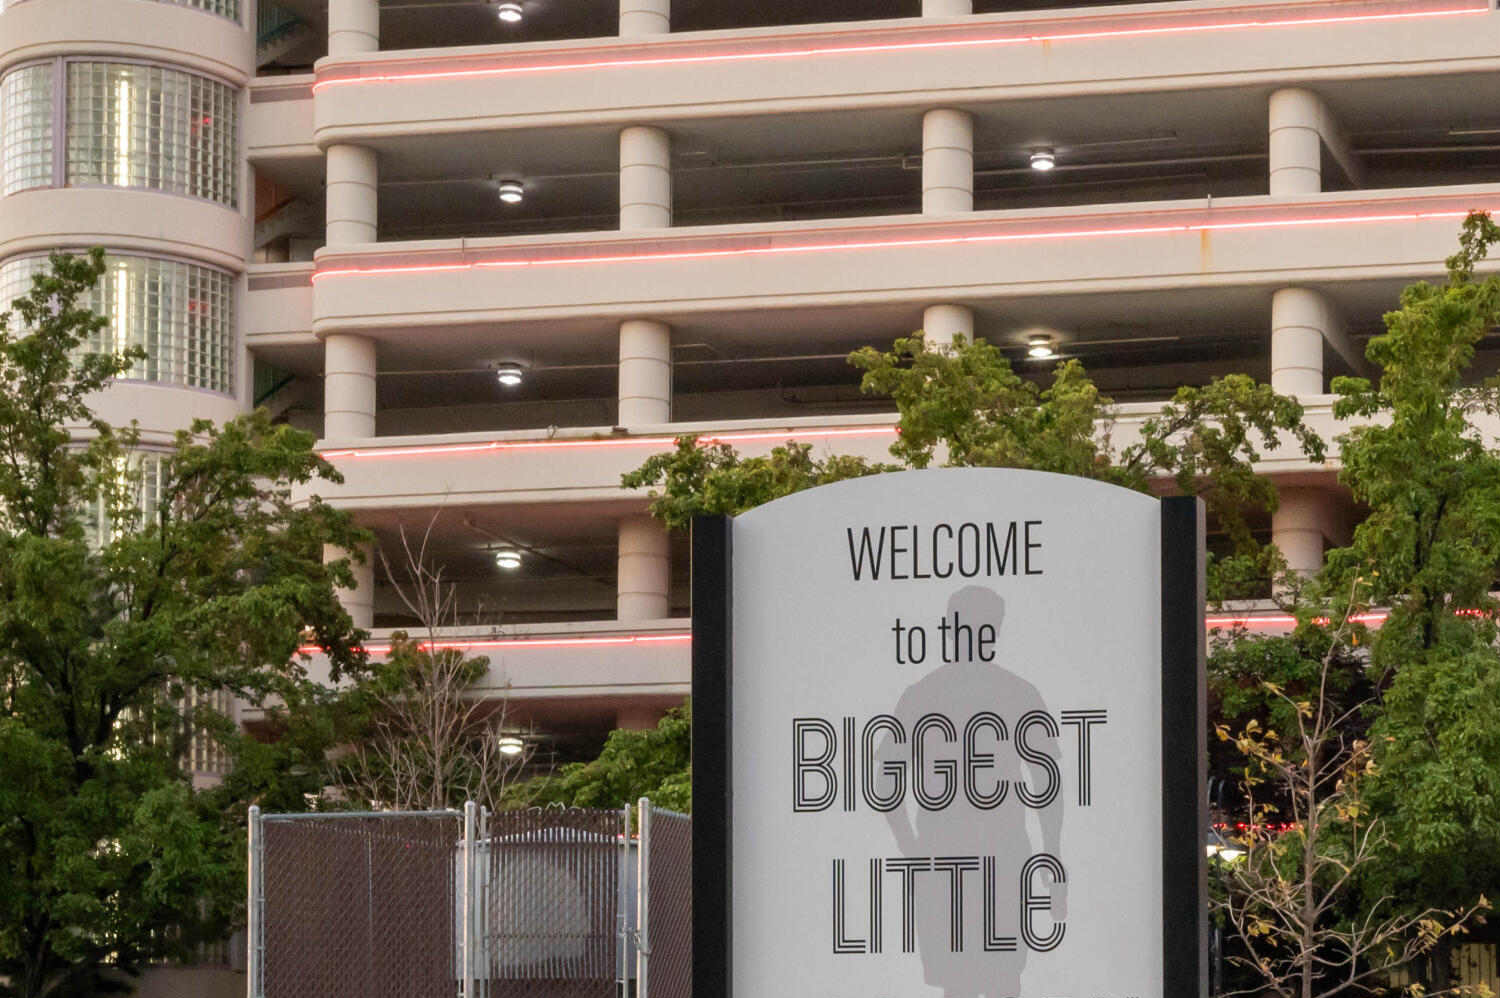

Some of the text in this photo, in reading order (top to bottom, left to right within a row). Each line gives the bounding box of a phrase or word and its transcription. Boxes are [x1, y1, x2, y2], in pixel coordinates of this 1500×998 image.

[848, 521, 1042, 580] WELCOME
[892, 612, 996, 665] to the
[793, 710, 1107, 812] BIGGEST
[832, 854, 1066, 954] LITTLE
